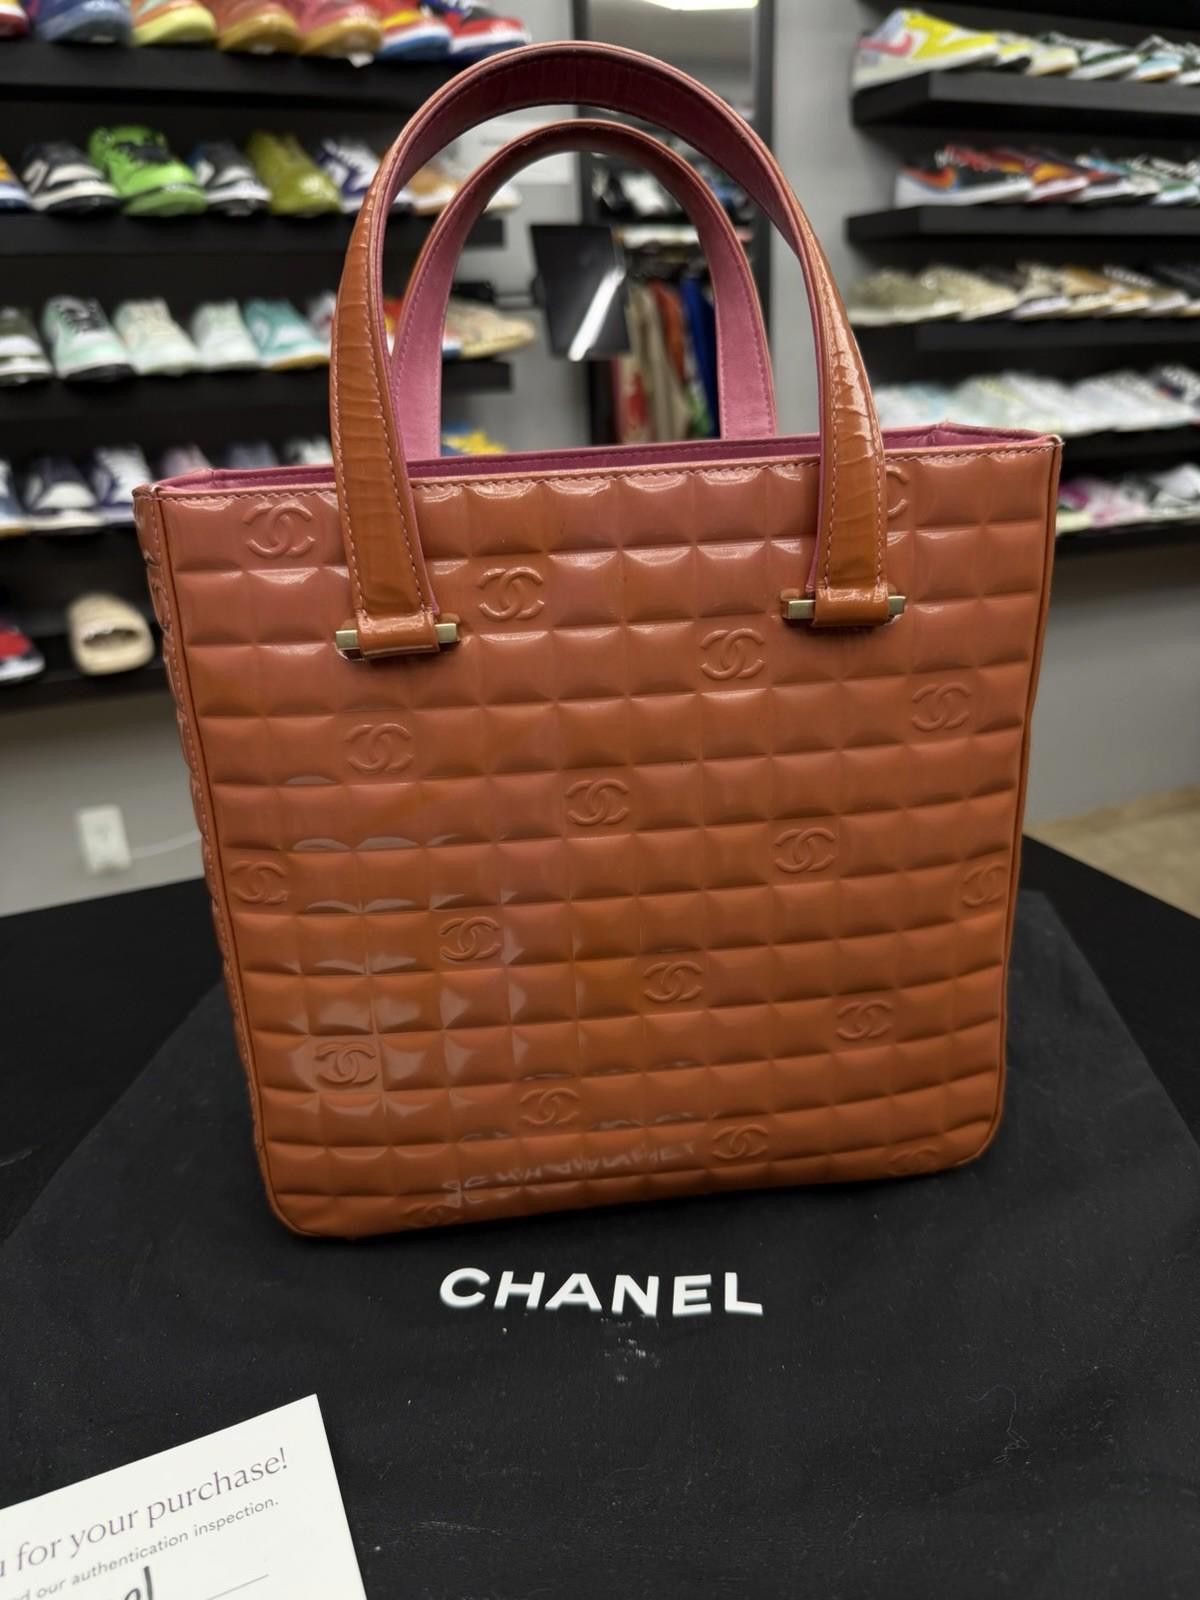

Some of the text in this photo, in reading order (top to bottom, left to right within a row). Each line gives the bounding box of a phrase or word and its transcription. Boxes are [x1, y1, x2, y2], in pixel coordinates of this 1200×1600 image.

[439, 1267, 763, 1317] CHANEL
[17, 1446, 288, 1571] for your purchase!
[36, 1579, 67, 1598] our
[71, 1531, 189, 1586] authentication
[193, 1498, 279, 1537] inspection.
